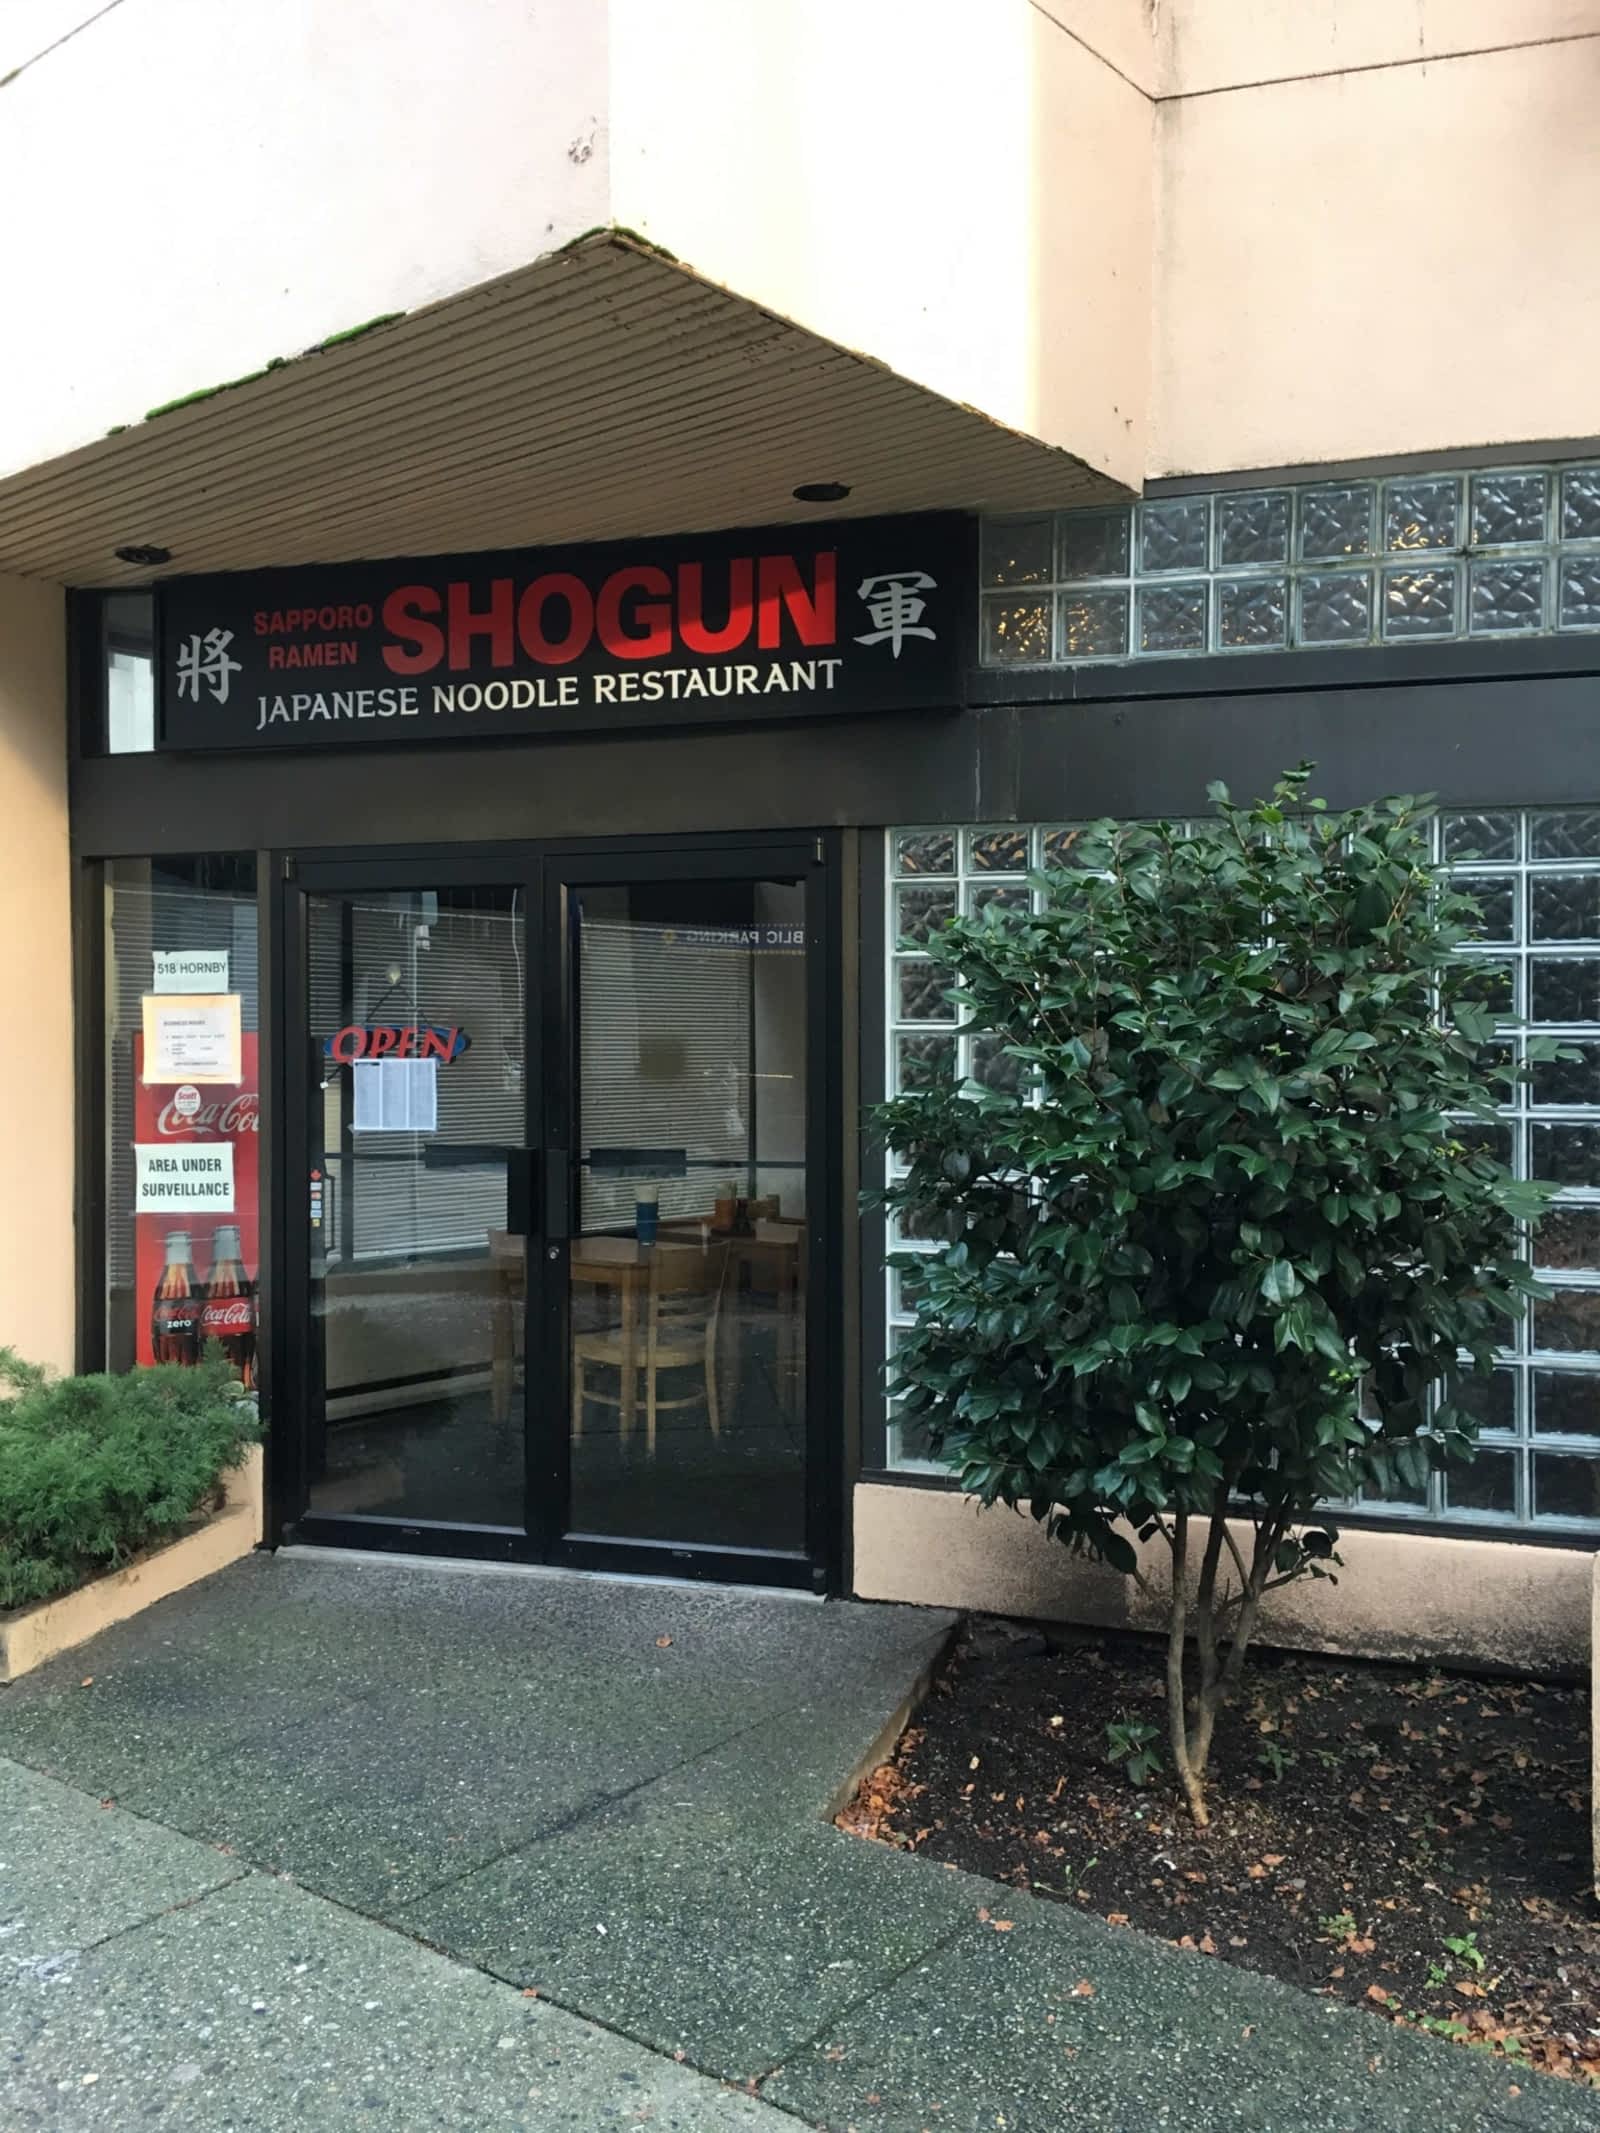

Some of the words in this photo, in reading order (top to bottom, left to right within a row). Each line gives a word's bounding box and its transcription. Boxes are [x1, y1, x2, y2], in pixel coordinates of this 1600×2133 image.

[254, 604, 374, 636] SAPPORO
[382, 552, 837, 675] SHOGUN
[853, 570, 938, 660] 軍
[269, 641, 358, 669] RAMEN
[256, 687, 419, 730] JAPANESE
[432, 675, 579, 713] NOODLE
[594, 658, 843, 704] RESTAURANT
[157, 963, 176, 975] 518
[179, 962, 226, 975] HORNBY
[331, 1026, 459, 1064] OPEN
[148, 1158, 178, 1173] AREA
[182, 1157, 222, 1172] UNDER
[141, 1182, 230, 1197] SURVEILLANCE
[167, 1319, 192, 1329] zero
